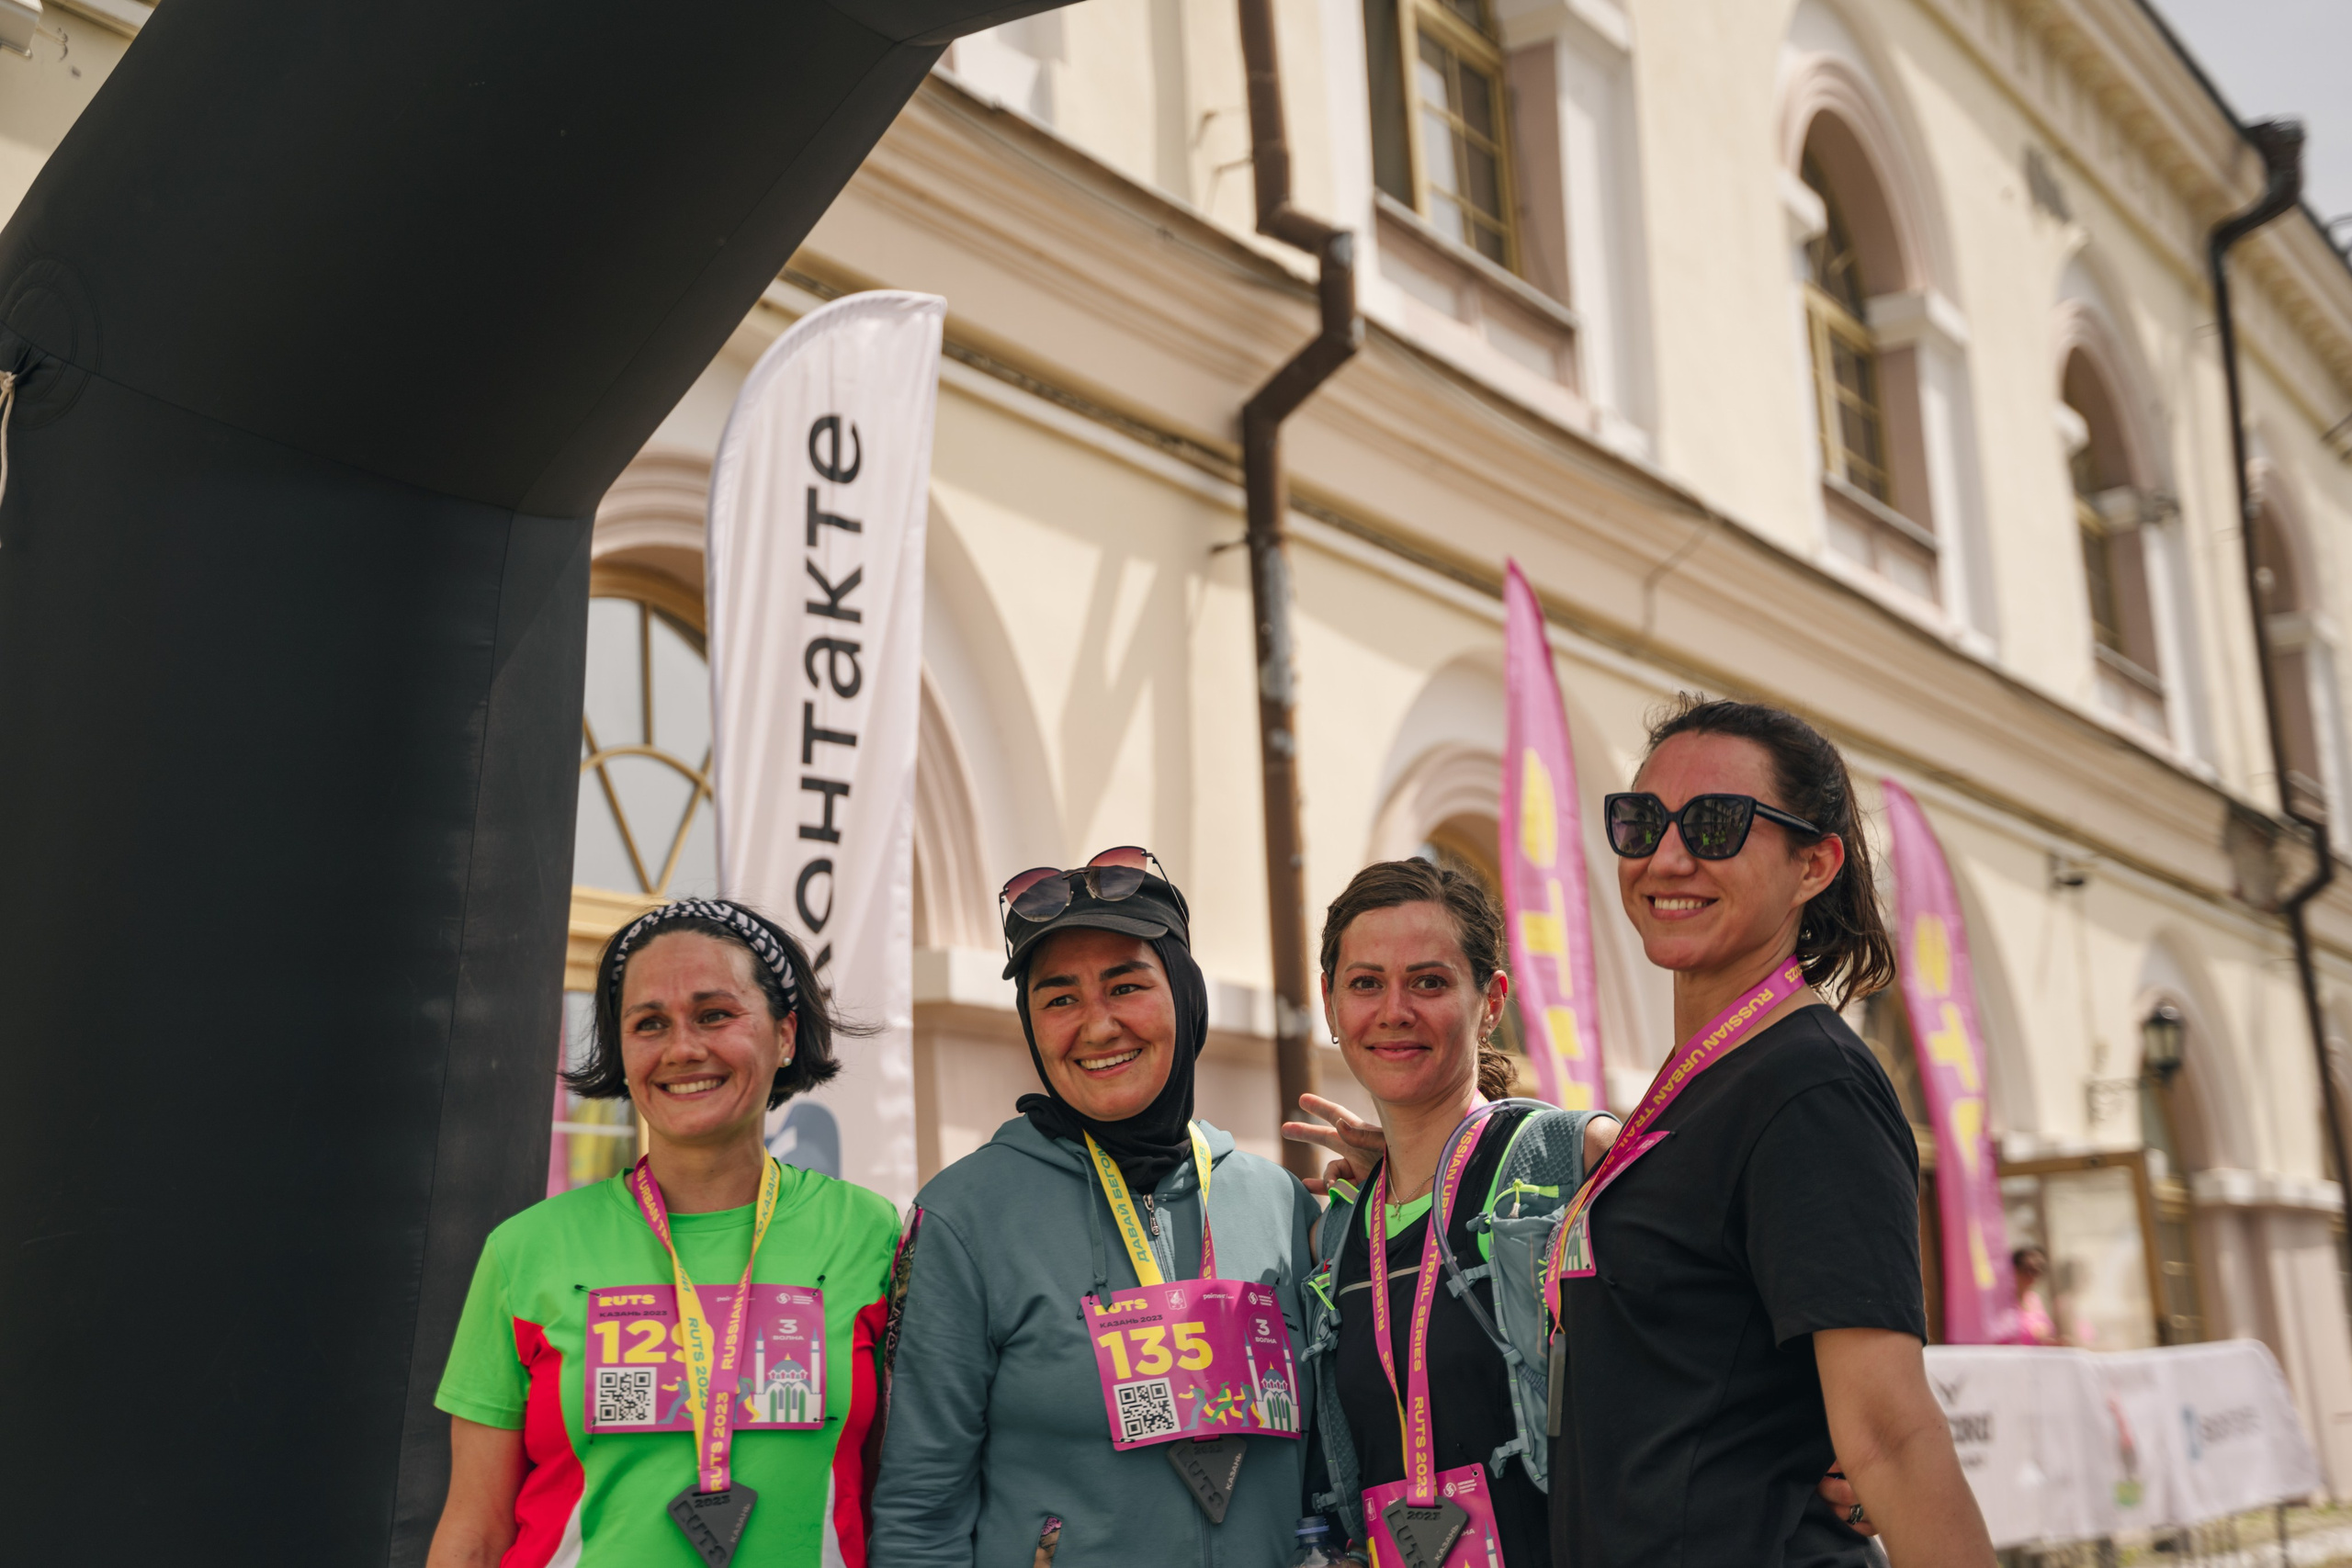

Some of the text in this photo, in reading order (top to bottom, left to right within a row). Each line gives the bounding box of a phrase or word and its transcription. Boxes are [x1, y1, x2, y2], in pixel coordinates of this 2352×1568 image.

[1702, 988, 1775, 1052] RUSSIAN
[1653, 1049, 1706, 1106] URBAN
[1449, 1120, 1480, 1181] USSIAN
[639, 1179, 660, 1223] URBAN
[1373, 1198, 1382, 1245] URBAN
[1116, 1203, 1149, 1262] ДАВАЙ
[1373, 1257, 1385, 1331] RUSSIAN
[1420, 1249, 1440, 1303] TRAIL
[599, 1293, 656, 1307] RUTS
[1099, 1314, 1163, 1329] КАЗАНЬ 2023
[687, 1317, 705, 1362] RUTS
[721, 1296, 743, 1370] RUSSIAN
[778, 1319, 797, 1334] 3
[1255, 1318, 1271, 1336] 3
[1414, 1305, 1426, 1371] SERIES
[1097, 1321, 1213, 1380] 135
[713, 1392, 729, 1438] 2023
[1414, 1396, 1426, 1448] RUTS
[710, 1441, 724, 1493] RUTS
[1225, 1452, 1242, 1490] КАЗАНЬ
[1416, 1452, 1427, 1498] 2023
[694, 1495, 731, 1507] 2023
[729, 1503, 752, 1543] КАЗАНЬ
[1406, 1511, 1442, 1520] 2023
[1434, 1524, 1459, 1561] КАЗАНЬ
